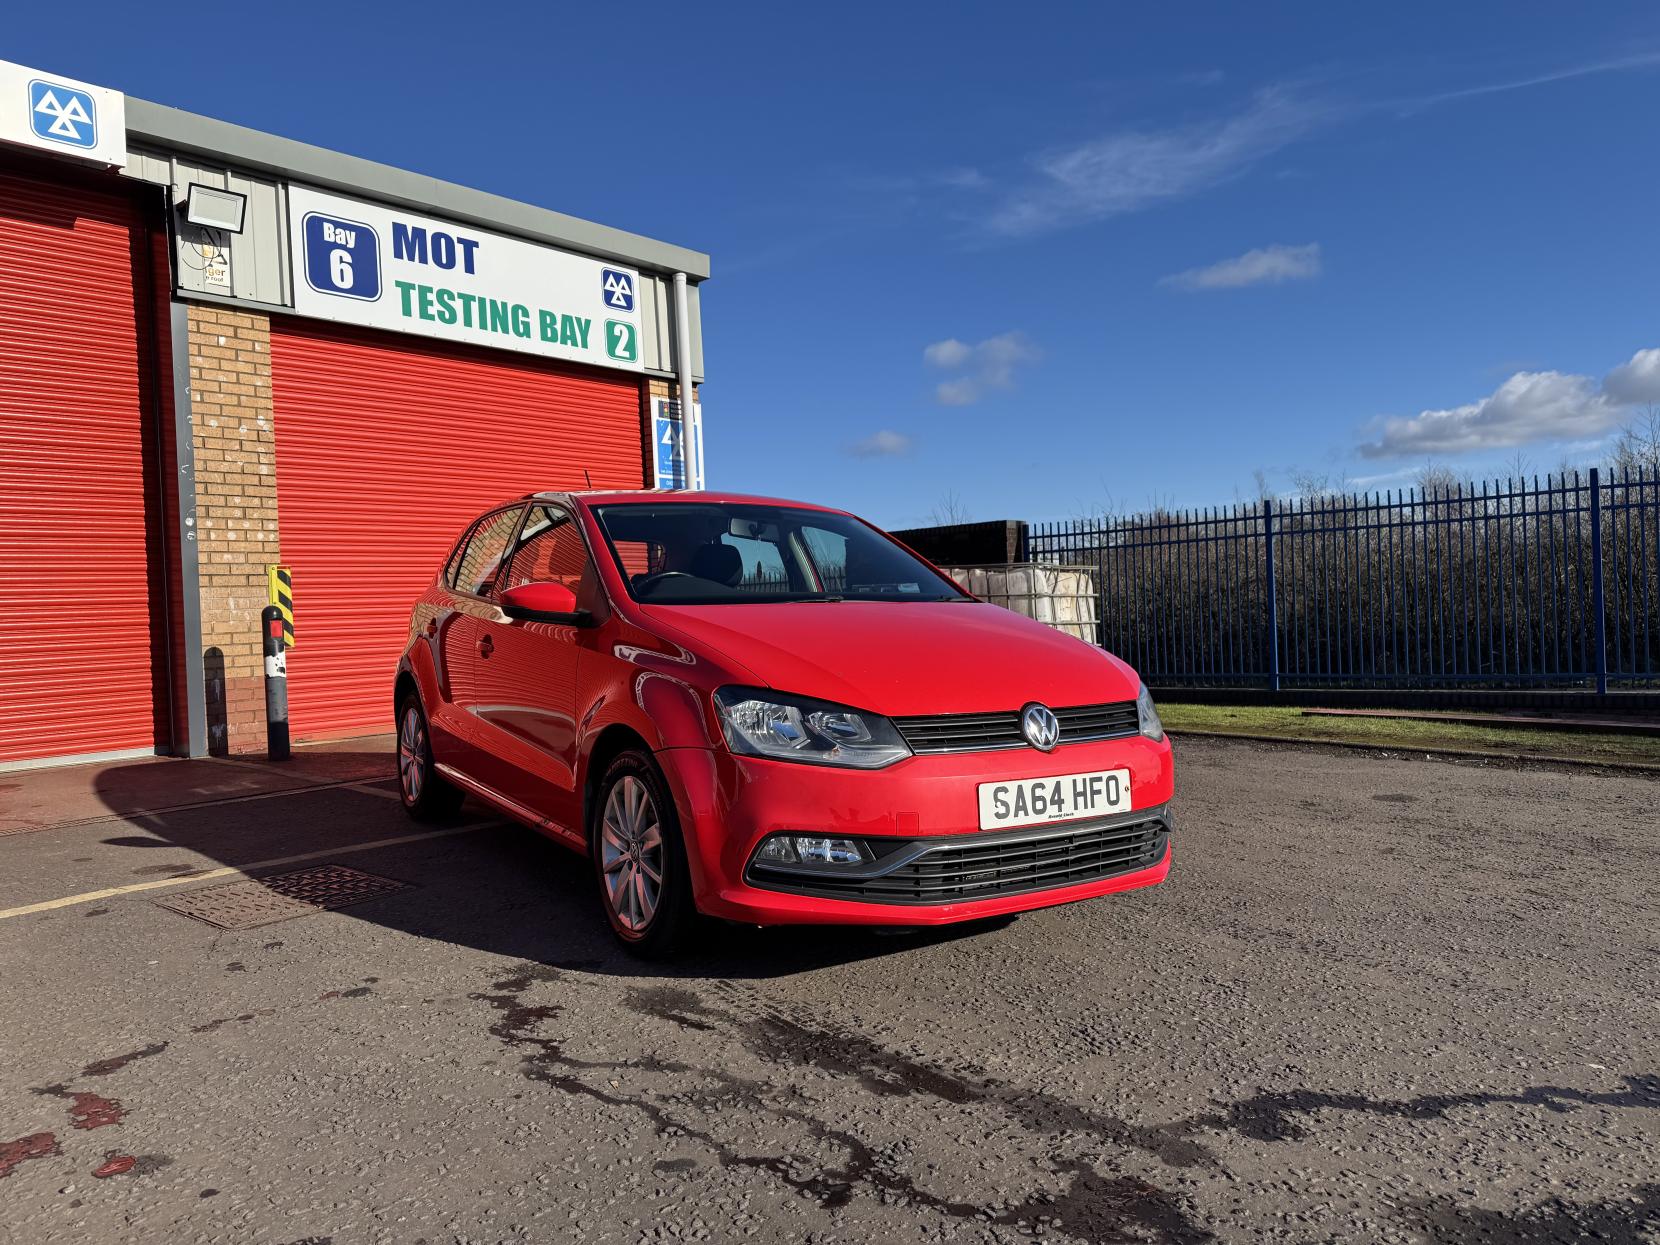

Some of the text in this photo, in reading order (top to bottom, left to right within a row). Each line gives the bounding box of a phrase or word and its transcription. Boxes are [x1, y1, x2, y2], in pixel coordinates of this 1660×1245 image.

[322, 221, 356, 249] Bay
[391, 221, 479, 275] MOT
[329, 249, 354, 290] 6
[395, 280, 592, 350] TESTING BAY
[614, 325, 631, 358] 2
[993, 774, 1120, 820] SA64 HFO
